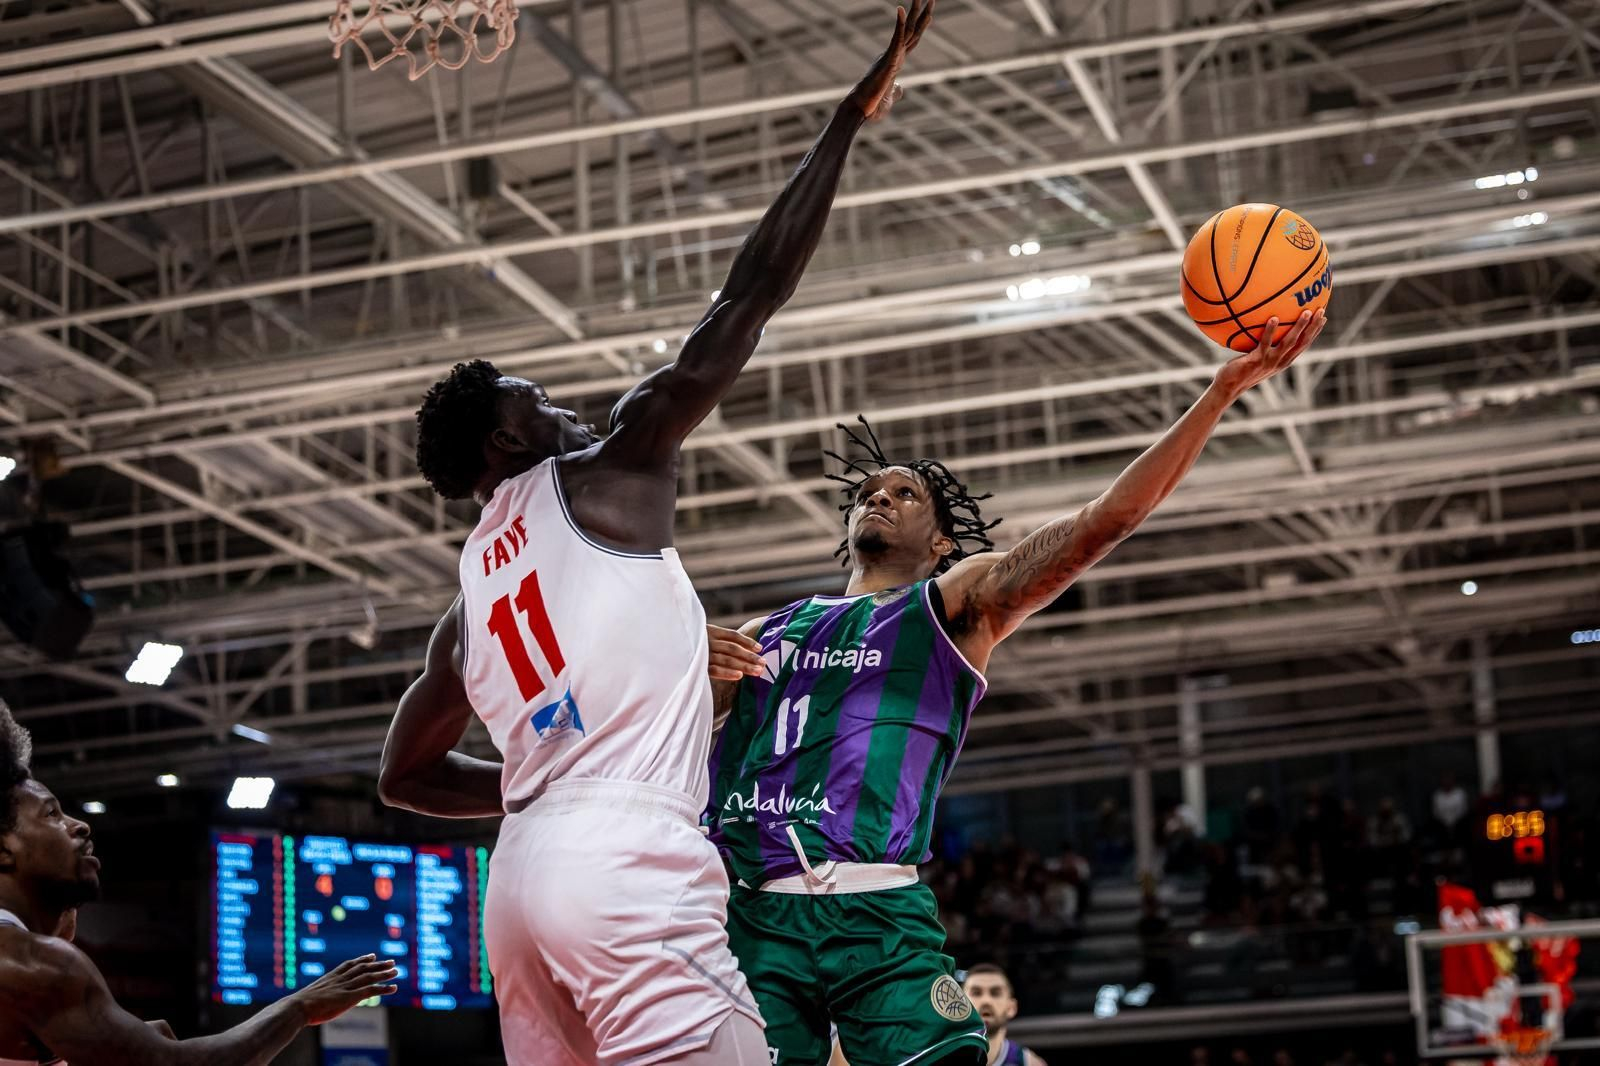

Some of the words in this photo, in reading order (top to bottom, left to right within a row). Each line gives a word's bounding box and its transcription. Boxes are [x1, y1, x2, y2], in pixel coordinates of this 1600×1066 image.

[482, 515, 529, 577] FAYE
[487, 569, 566, 703] 11
[774, 694, 811, 755] 11
[723, 780, 836, 814] ndalucía
